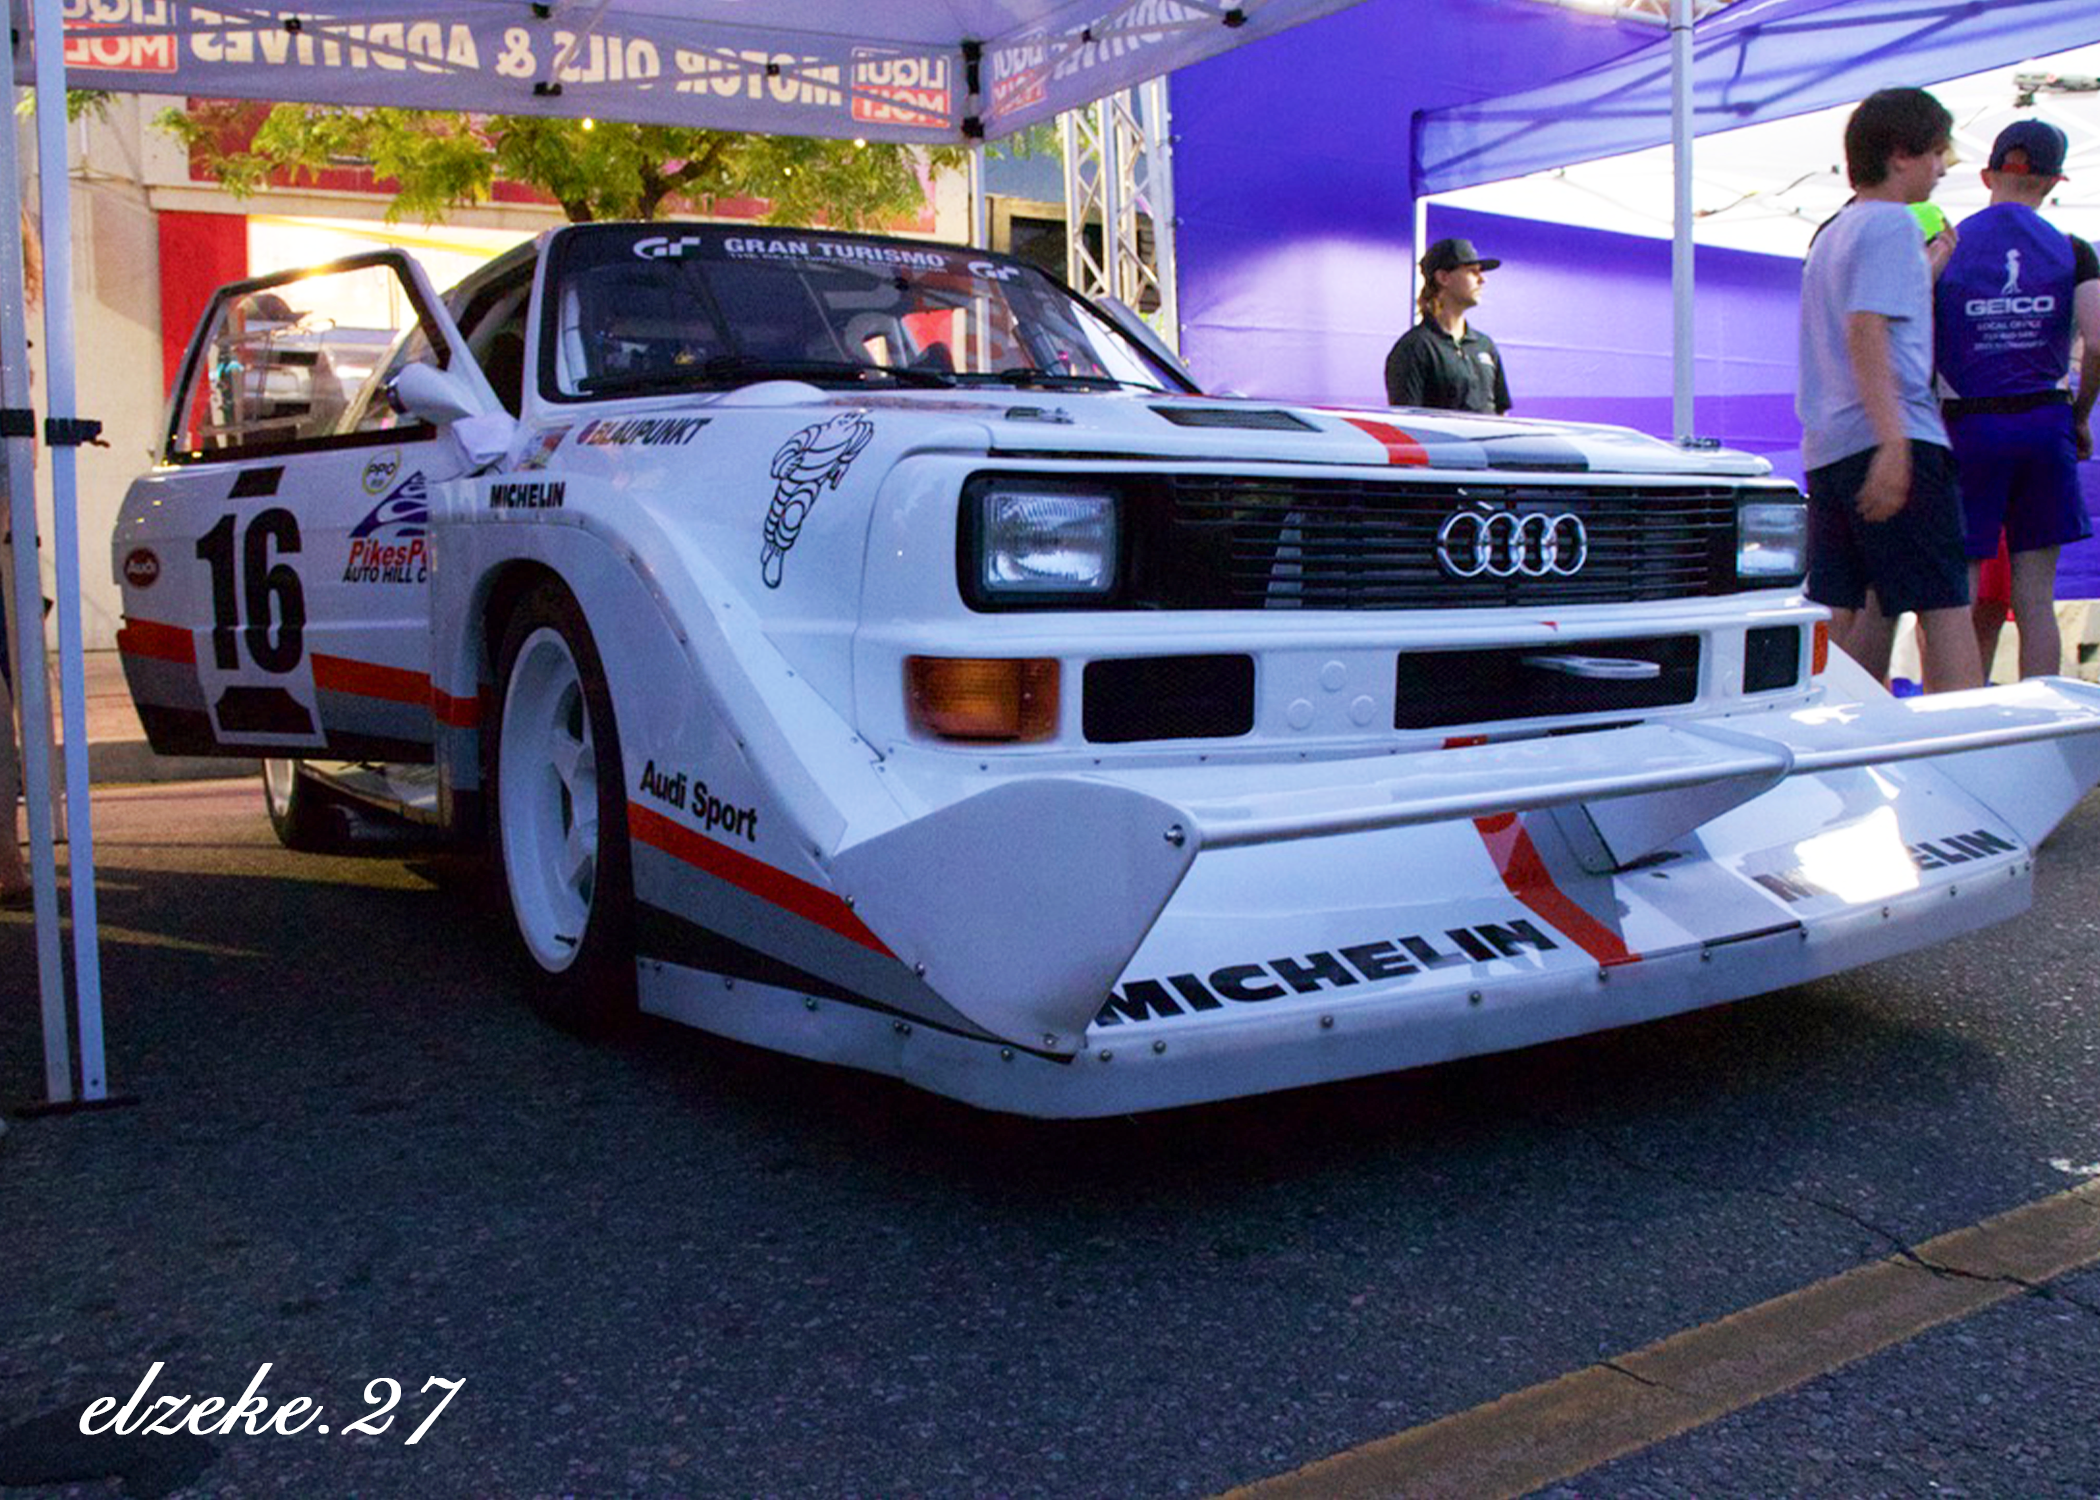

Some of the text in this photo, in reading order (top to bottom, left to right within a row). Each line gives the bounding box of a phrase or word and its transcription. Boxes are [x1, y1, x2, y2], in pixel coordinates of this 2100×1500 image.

[723, 237, 809, 255] GRAN
[816, 243, 944, 268] TURISMO
[1965, 296, 2055, 317] GEICO
[588, 417, 713, 446] BLAUPUNKT
[489, 481, 566, 509] MICHELIN
[342, 565, 380, 583] AUTO
[382, 565, 414, 583] HILL
[196, 507, 307, 674] 16
[639, 759, 758, 843] Audi Sport
[1094, 919, 1560, 1027] MICHELIN
